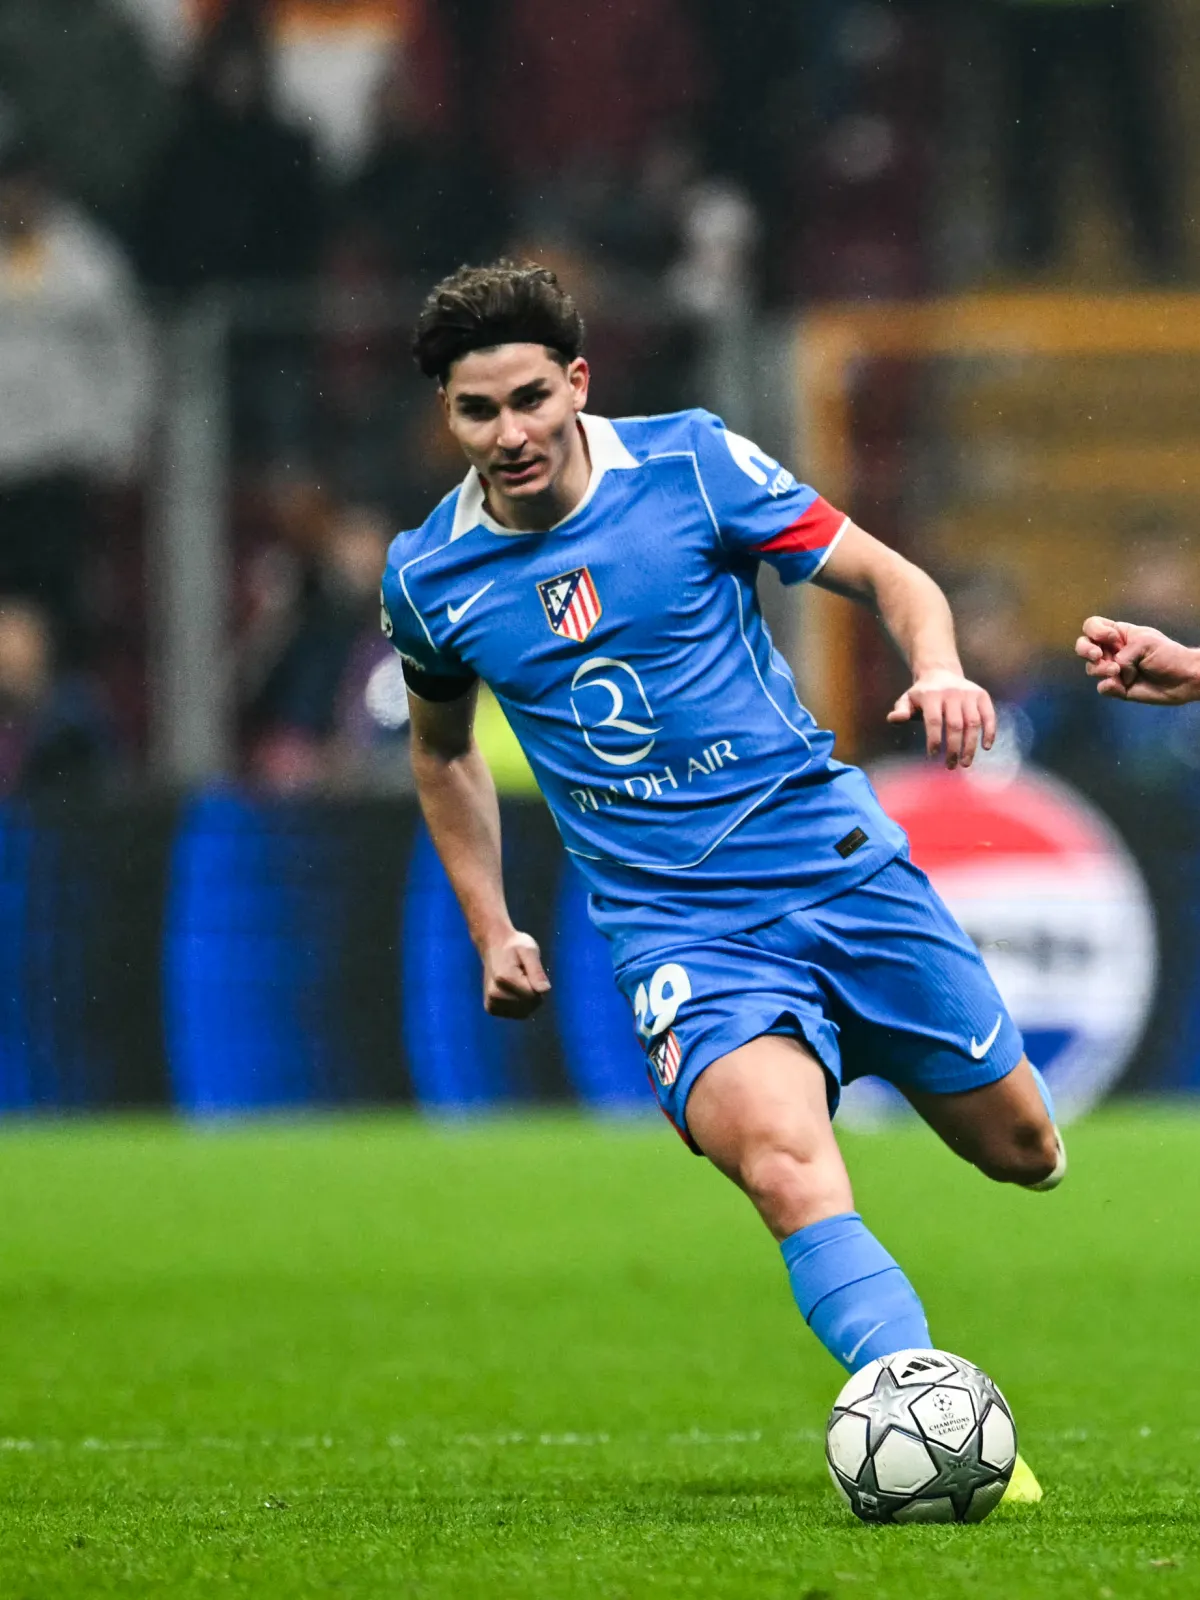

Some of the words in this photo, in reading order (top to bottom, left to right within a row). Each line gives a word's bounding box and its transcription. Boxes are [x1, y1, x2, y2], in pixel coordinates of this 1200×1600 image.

[570, 766, 678, 814] RIDH
[688, 739, 739, 783] AIR
[928, 1417, 970, 1431] CHAMPIONS
